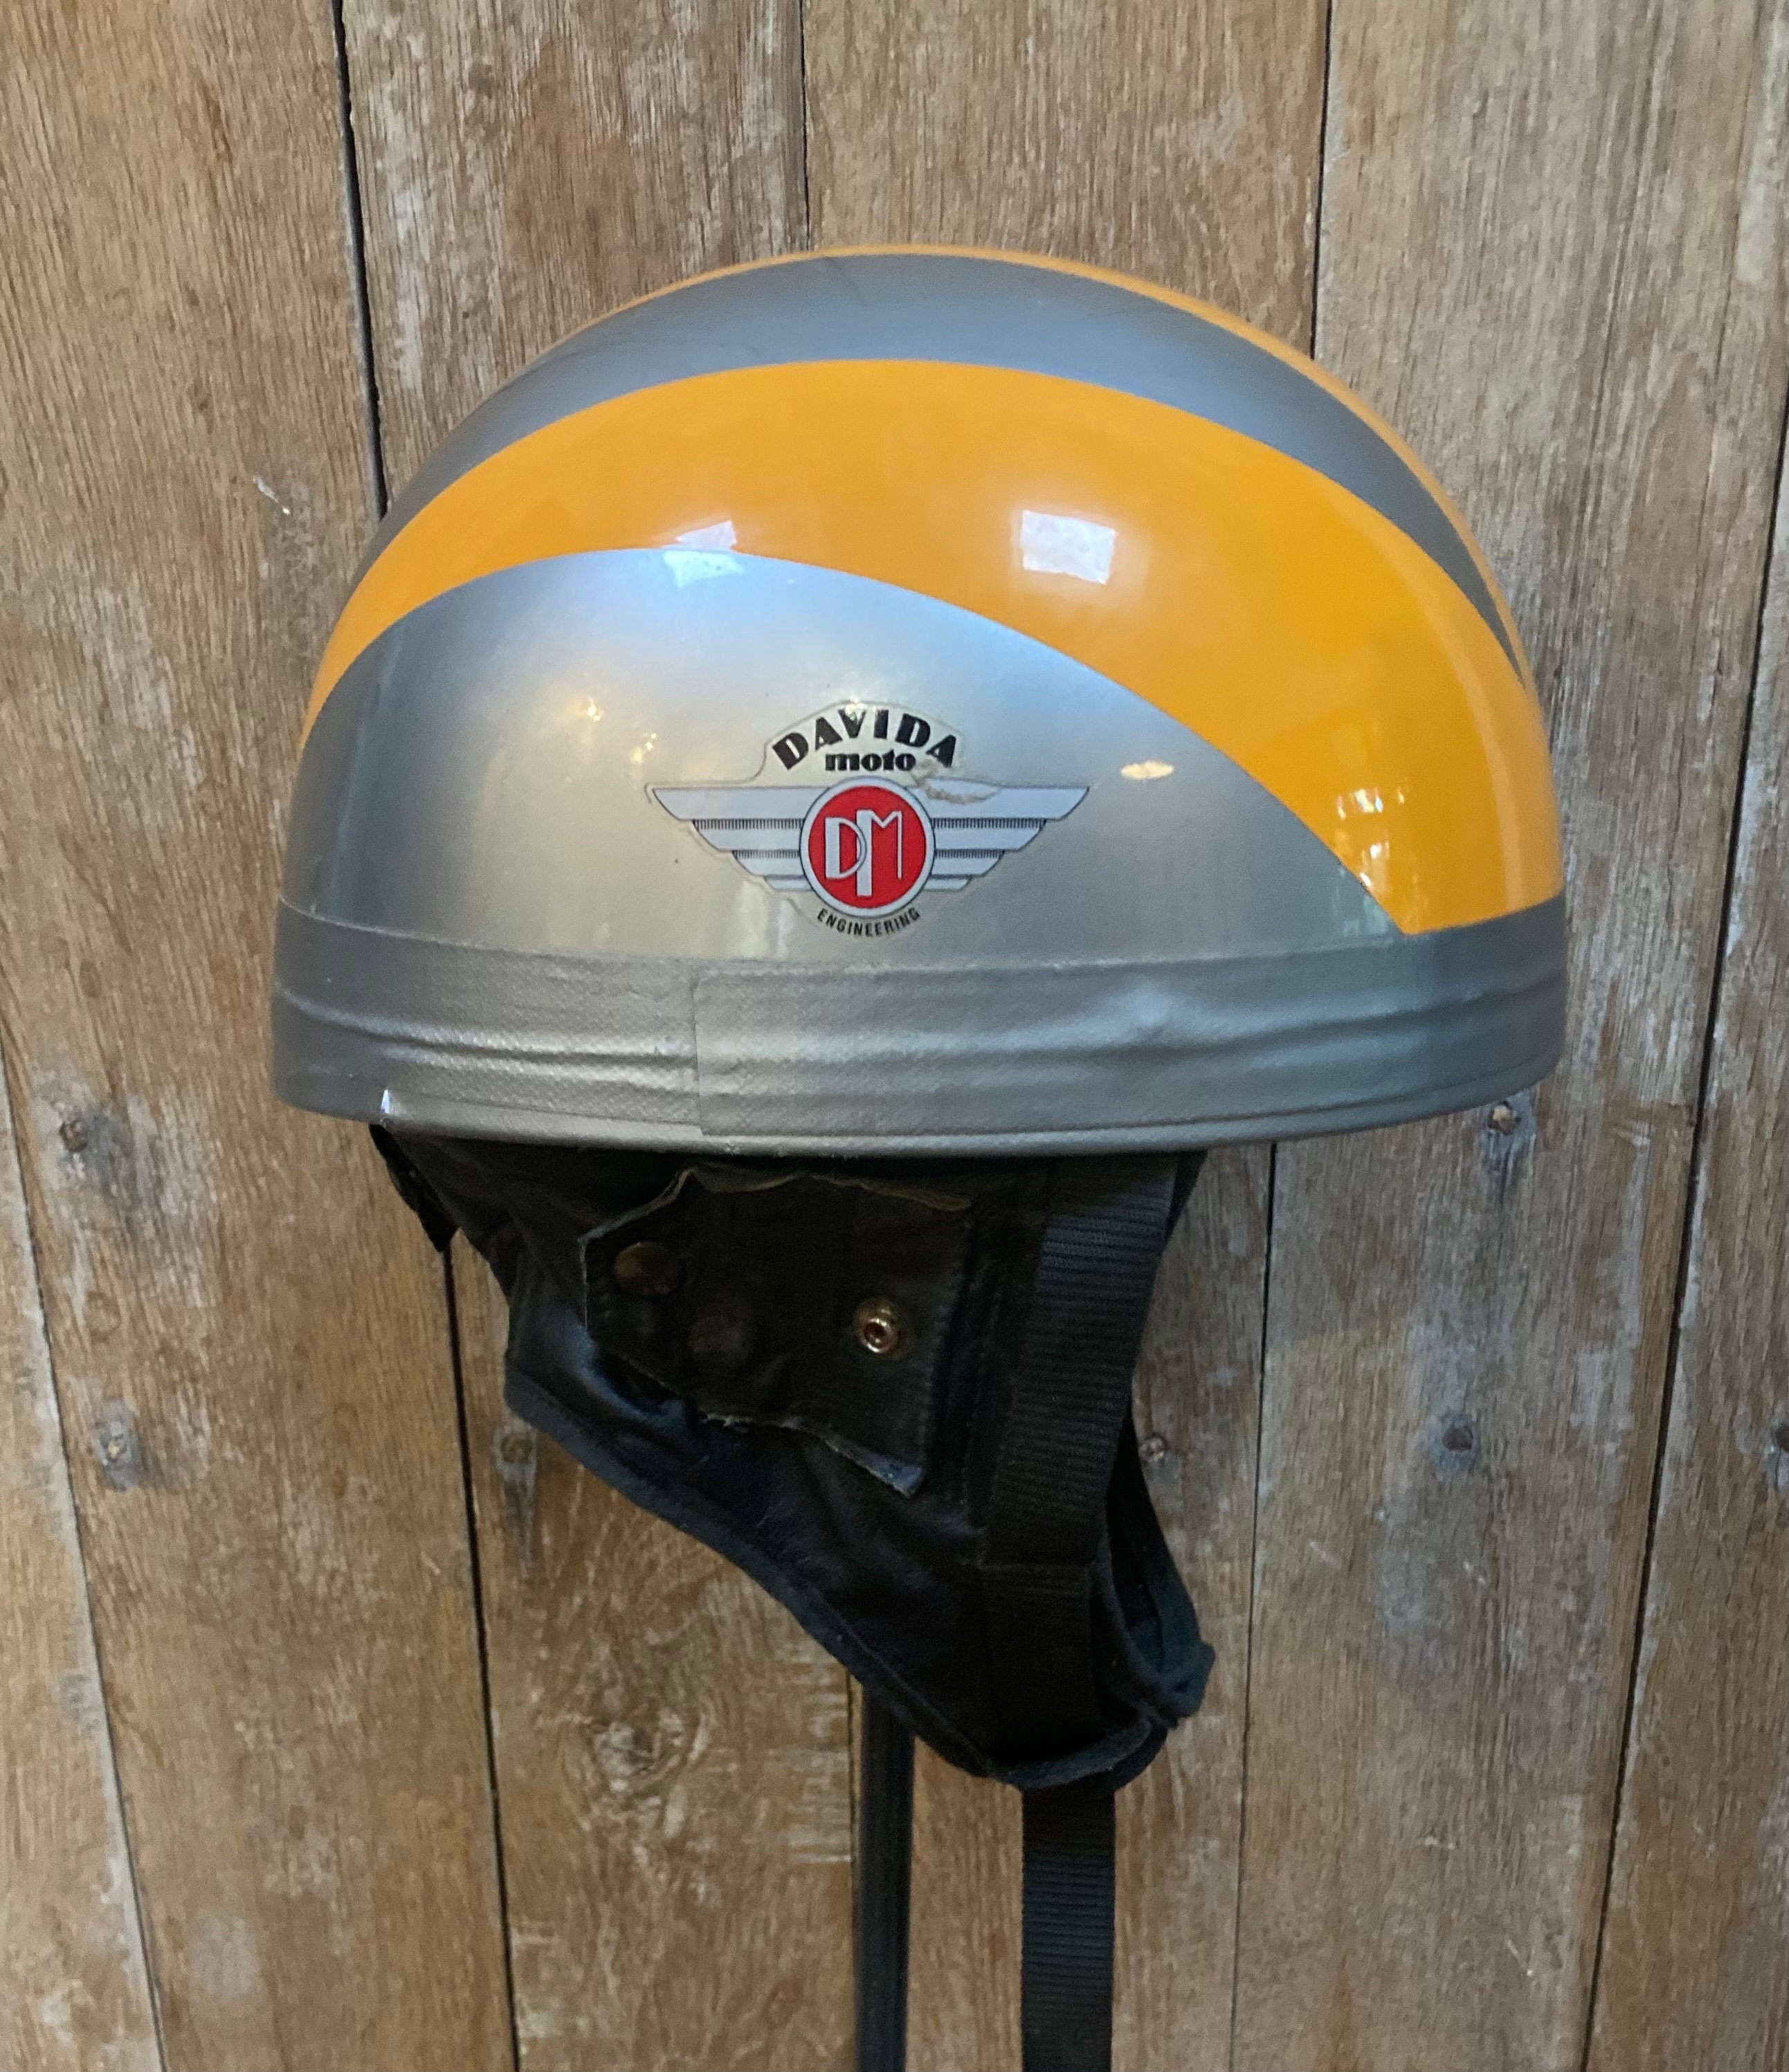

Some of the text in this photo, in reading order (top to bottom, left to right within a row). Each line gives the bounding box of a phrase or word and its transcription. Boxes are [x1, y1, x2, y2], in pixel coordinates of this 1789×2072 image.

[772, 709, 956, 770] DAVIDA
[825, 750, 916, 771] moto
[817, 908, 920, 936] ENGINEERING
